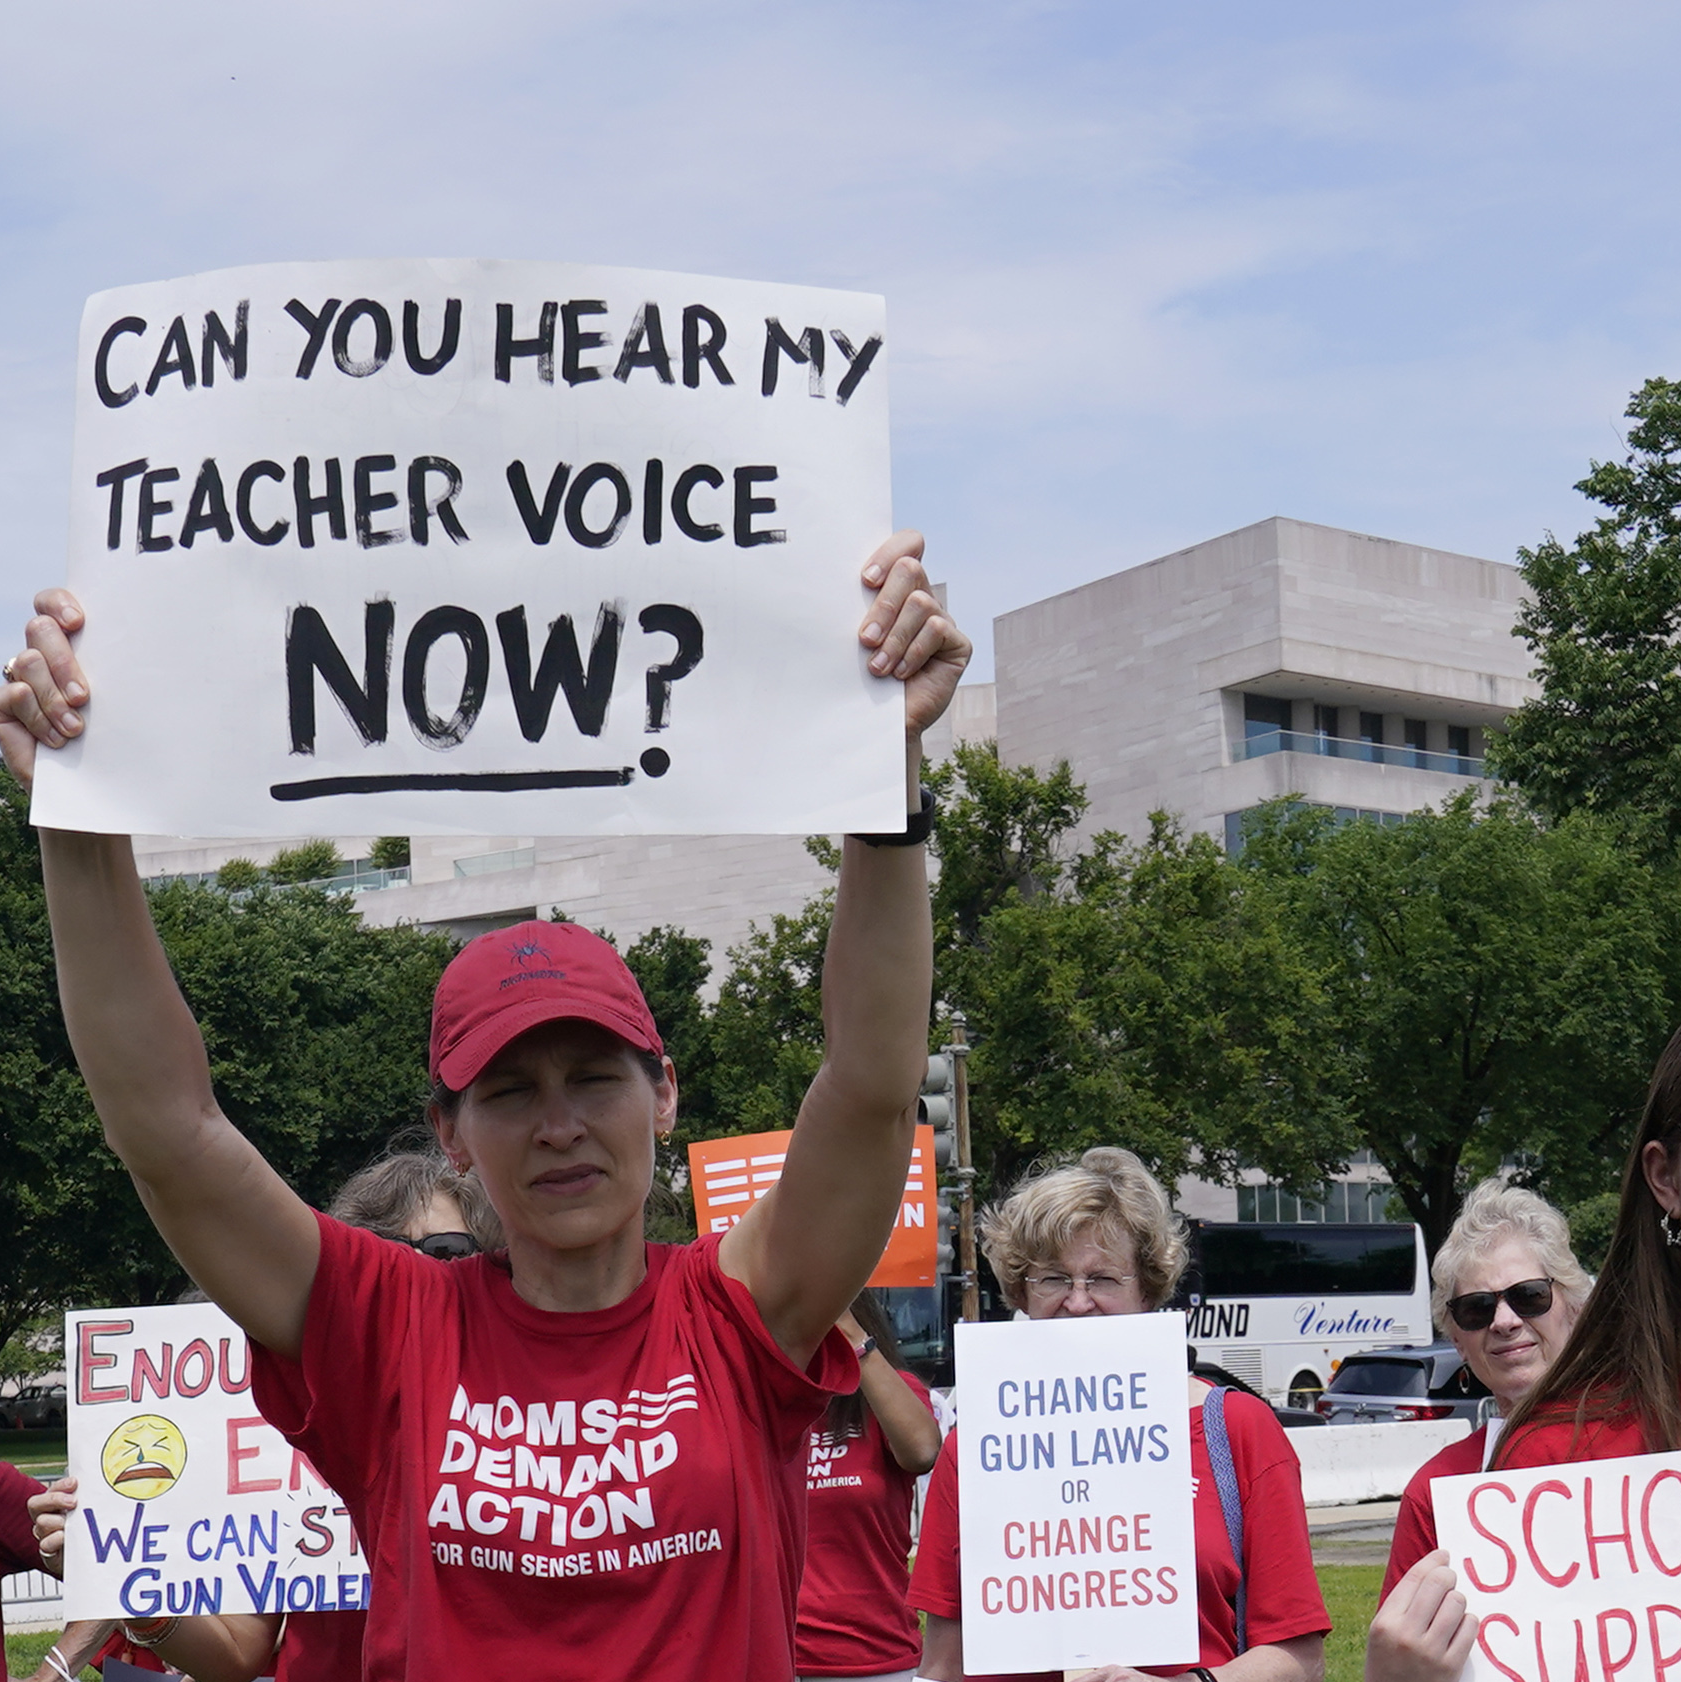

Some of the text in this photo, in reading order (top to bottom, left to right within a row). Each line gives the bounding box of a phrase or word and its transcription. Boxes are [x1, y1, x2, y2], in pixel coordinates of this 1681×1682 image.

[95, 297, 884, 409] CAN YOU HEAR MY
[96, 455, 788, 556] TEACHER VOICE
[286, 592, 705, 778] NOW?
[1294, 1301, 1395, 1336] Venture
[449, 1383, 619, 1446] MOMS
[998, 1371, 1148, 1417] CHANGE
[439, 1430, 678, 1498] DEMAND
[979, 1422, 1170, 1473] GUN LAWS
[816, 1475, 862, 1489] AMERICA
[1060, 1478, 1091, 1504] OR
[83, 1503, 167, 1563] WE
[187, 1510, 278, 1561] CAN
[427, 1483, 655, 1547] ACTION
[1003, 1512, 1153, 1560] CHANGE
[470, 1543, 513, 1573] GUN
[521, 1552, 593, 1577] SENSE
[598, 1549, 621, 1572] IN
[628, 1528, 722, 1568] AMERICA
[119, 1568, 221, 1616] GUN
[980, 1567, 1179, 1616] CONGRESS
